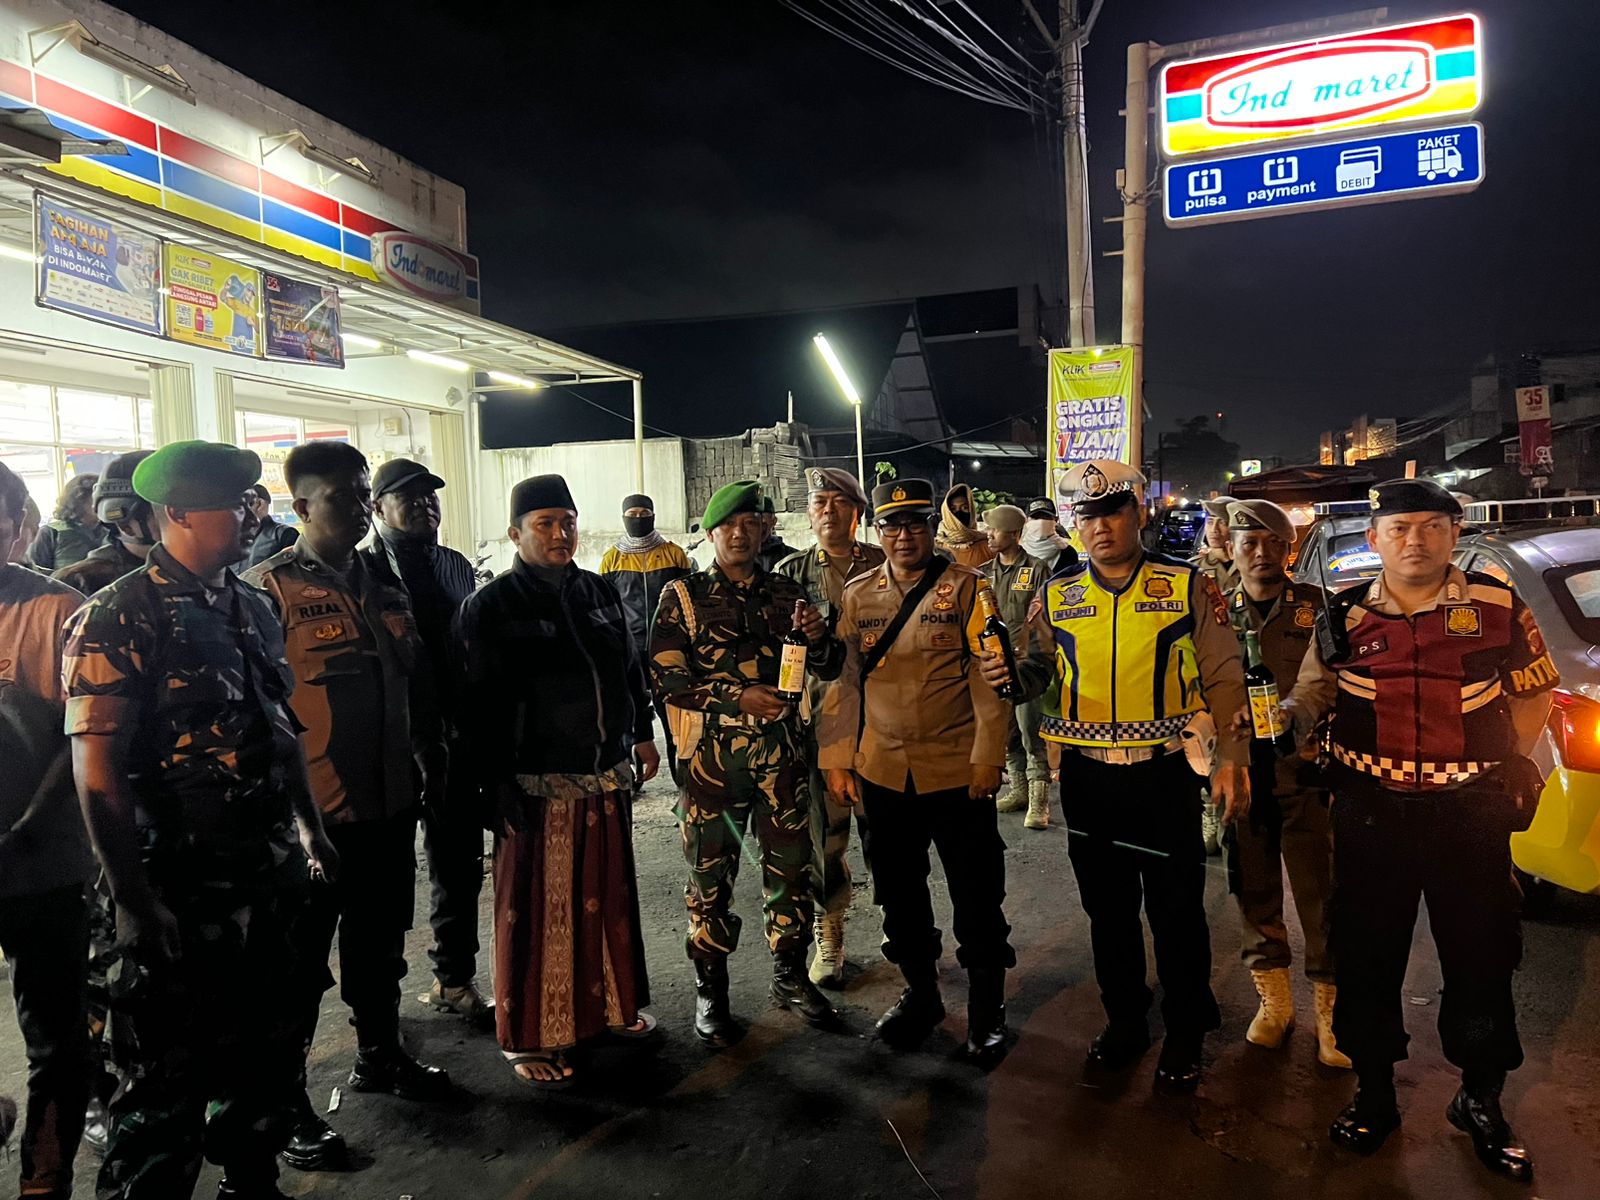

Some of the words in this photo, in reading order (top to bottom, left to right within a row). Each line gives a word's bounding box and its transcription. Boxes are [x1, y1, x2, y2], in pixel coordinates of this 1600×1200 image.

[1418, 134, 1460, 150] PAKET
[1341, 176, 1371, 189] DEBIT
[1247, 180, 1316, 203] payment
[1185, 195, 1227, 212] pulsa
[54, 244, 75, 259] BISA
[48, 255, 59, 266] DI
[1524, 389, 1543, 405] 35
[1055, 396, 1121, 417] GRATIS
[1055, 412, 1121, 429] ONGKIR
[1073, 431, 1120, 449] JAM
[300, 602, 342, 618] RIZAL
[1140, 601, 1179, 611] POLRI
[920, 613, 960, 624] POLRI
